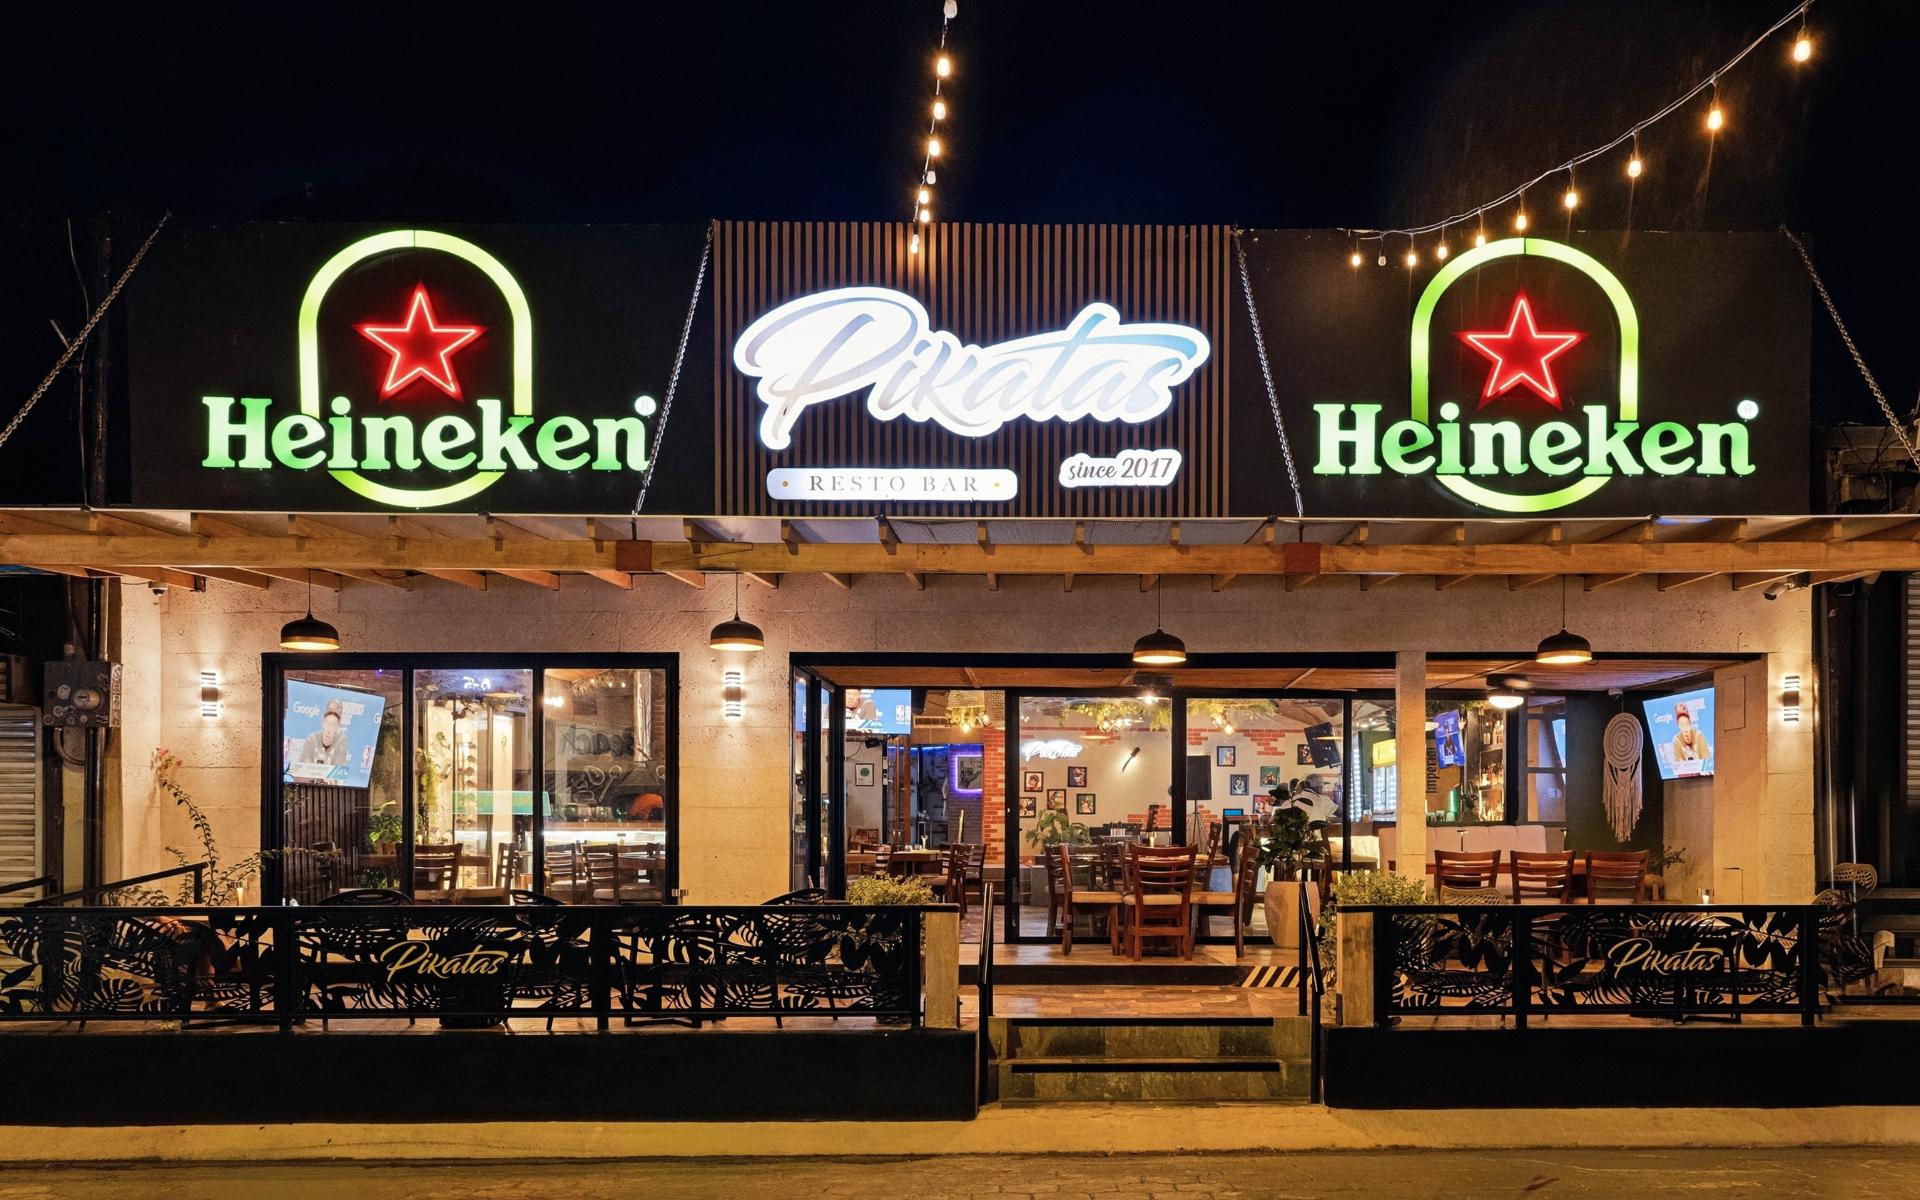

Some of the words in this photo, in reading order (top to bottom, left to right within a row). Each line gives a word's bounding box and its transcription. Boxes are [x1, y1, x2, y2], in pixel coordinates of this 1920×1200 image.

[743, 294, 1200, 441] Pikatas
[202, 396, 650, 471] Heineken
[1312, 402, 1756, 476] Heineken
[810, 475, 906, 493] RESTO
[923, 475, 979, 493] BAR
[1068, 459, 1117, 481] since
[1121, 457, 1173, 480] 2017
[380, 940, 508, 982] Pikatas
[1608, 937, 1725, 979] Pikatas
